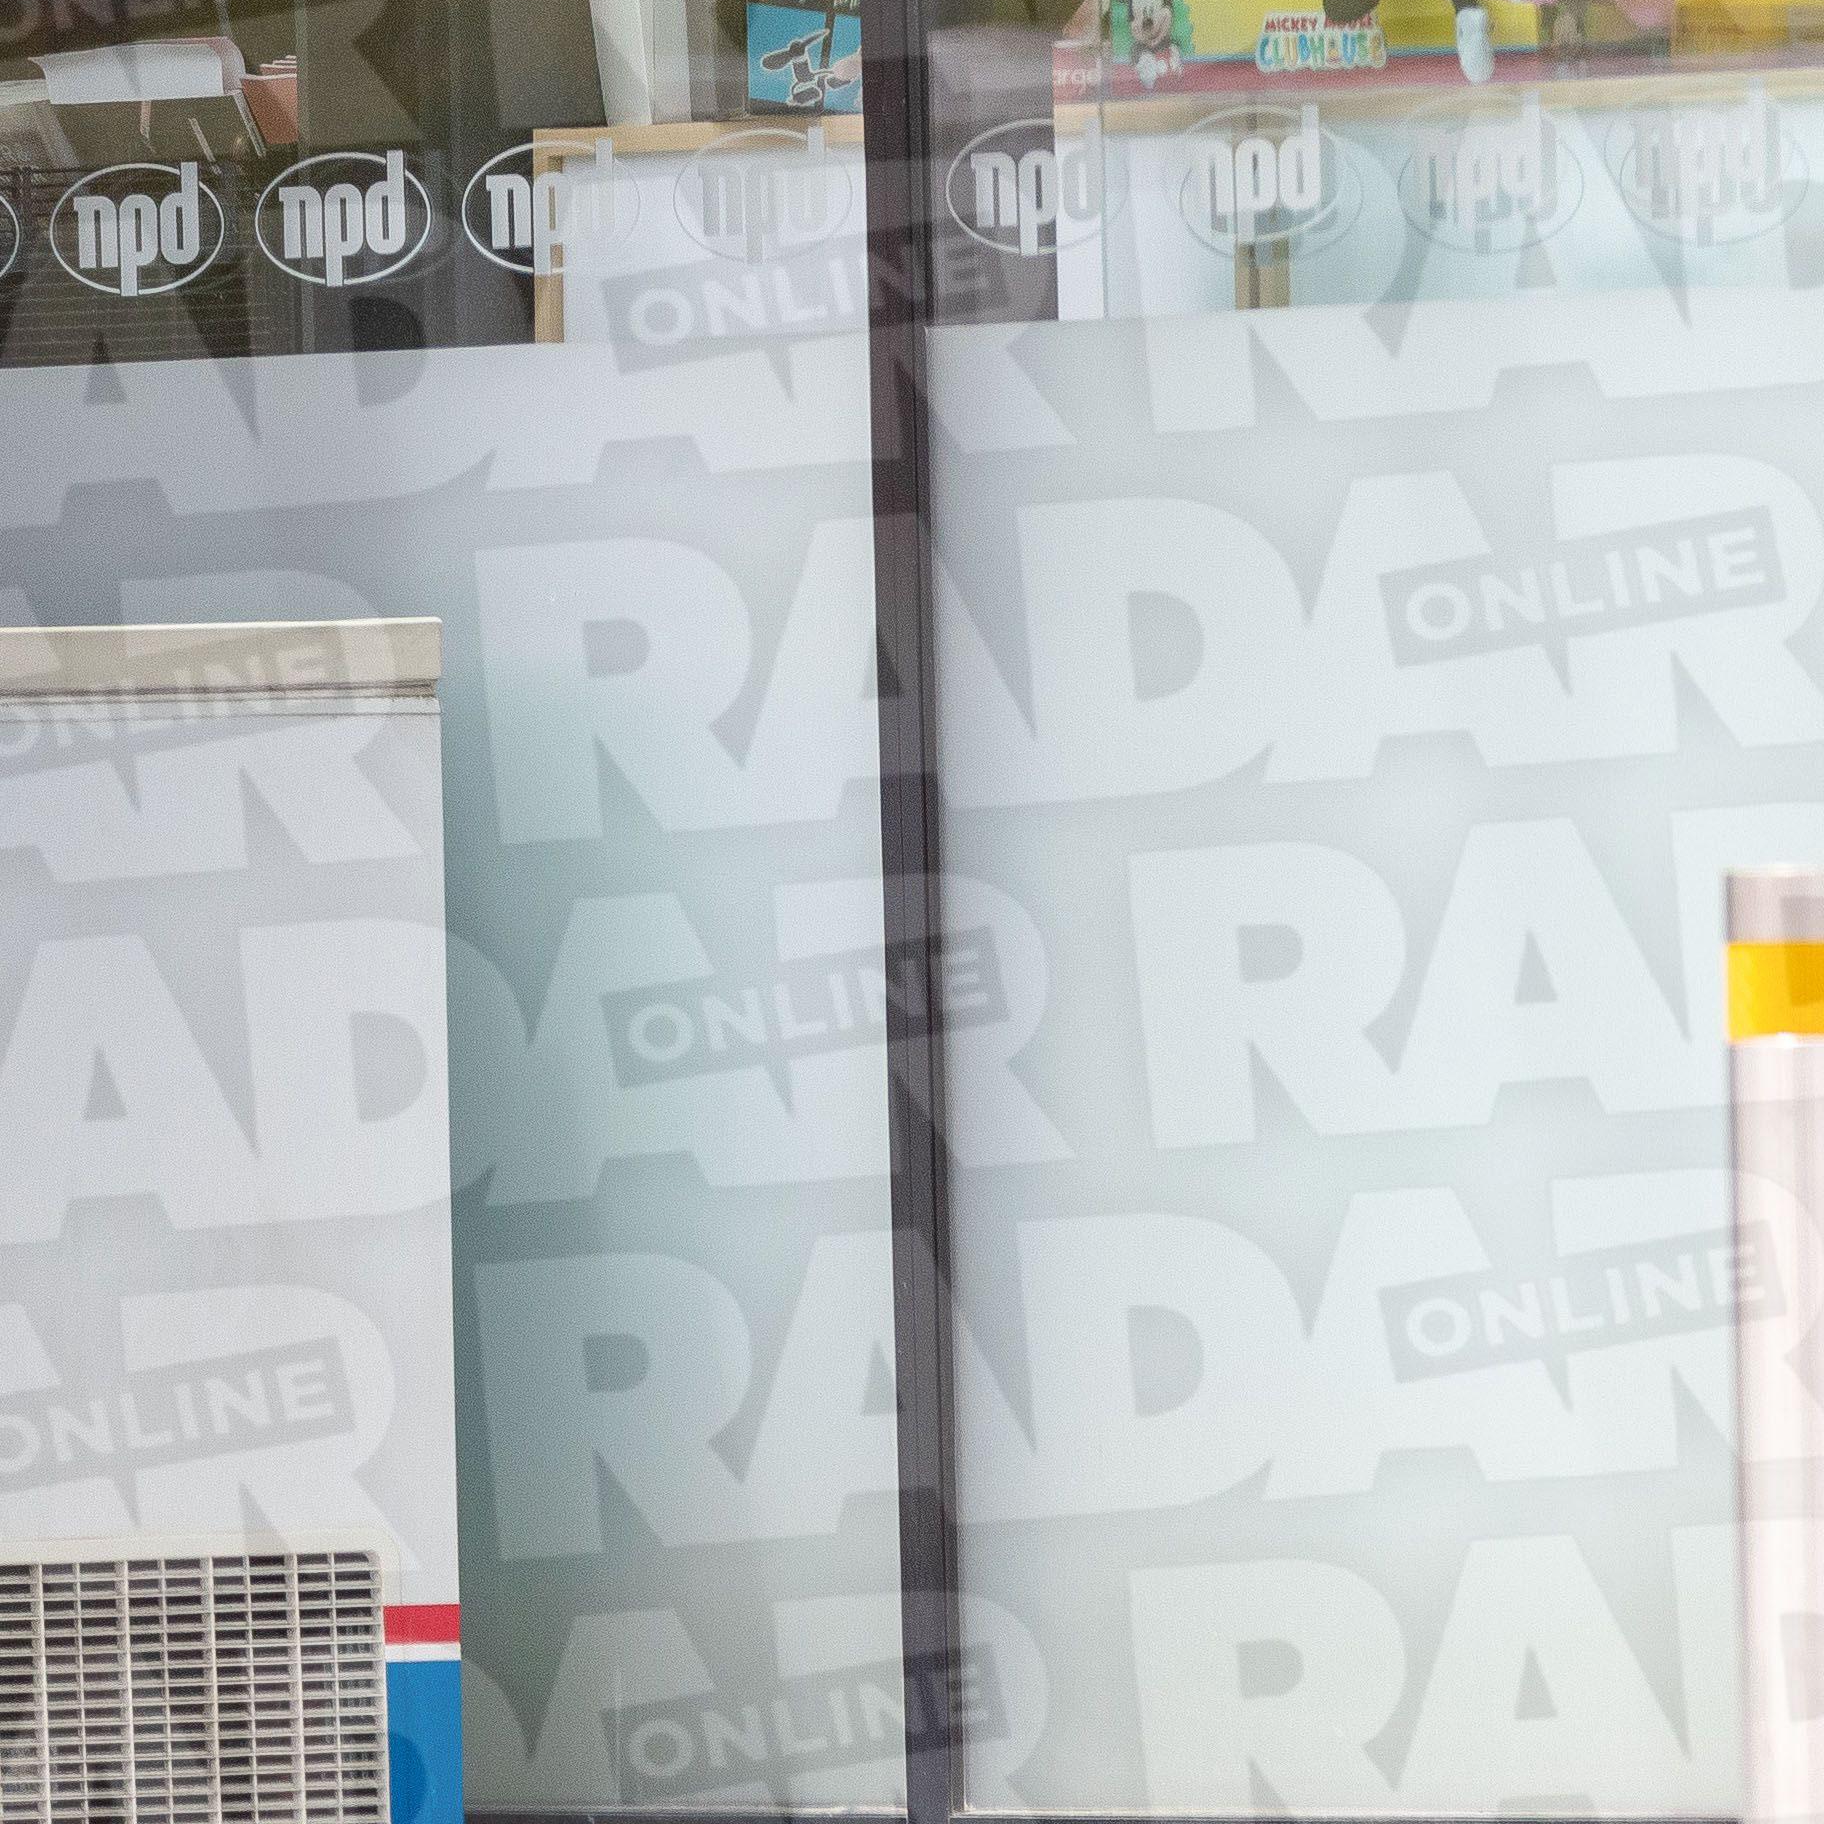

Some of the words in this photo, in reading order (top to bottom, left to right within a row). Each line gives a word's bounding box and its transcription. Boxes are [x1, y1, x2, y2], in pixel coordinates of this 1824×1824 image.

[74, 162, 198, 297] npd
[279, 150, 406, 287] npd
[486, 138, 612, 273] npd
[1206, 104, 1320, 240] npd
